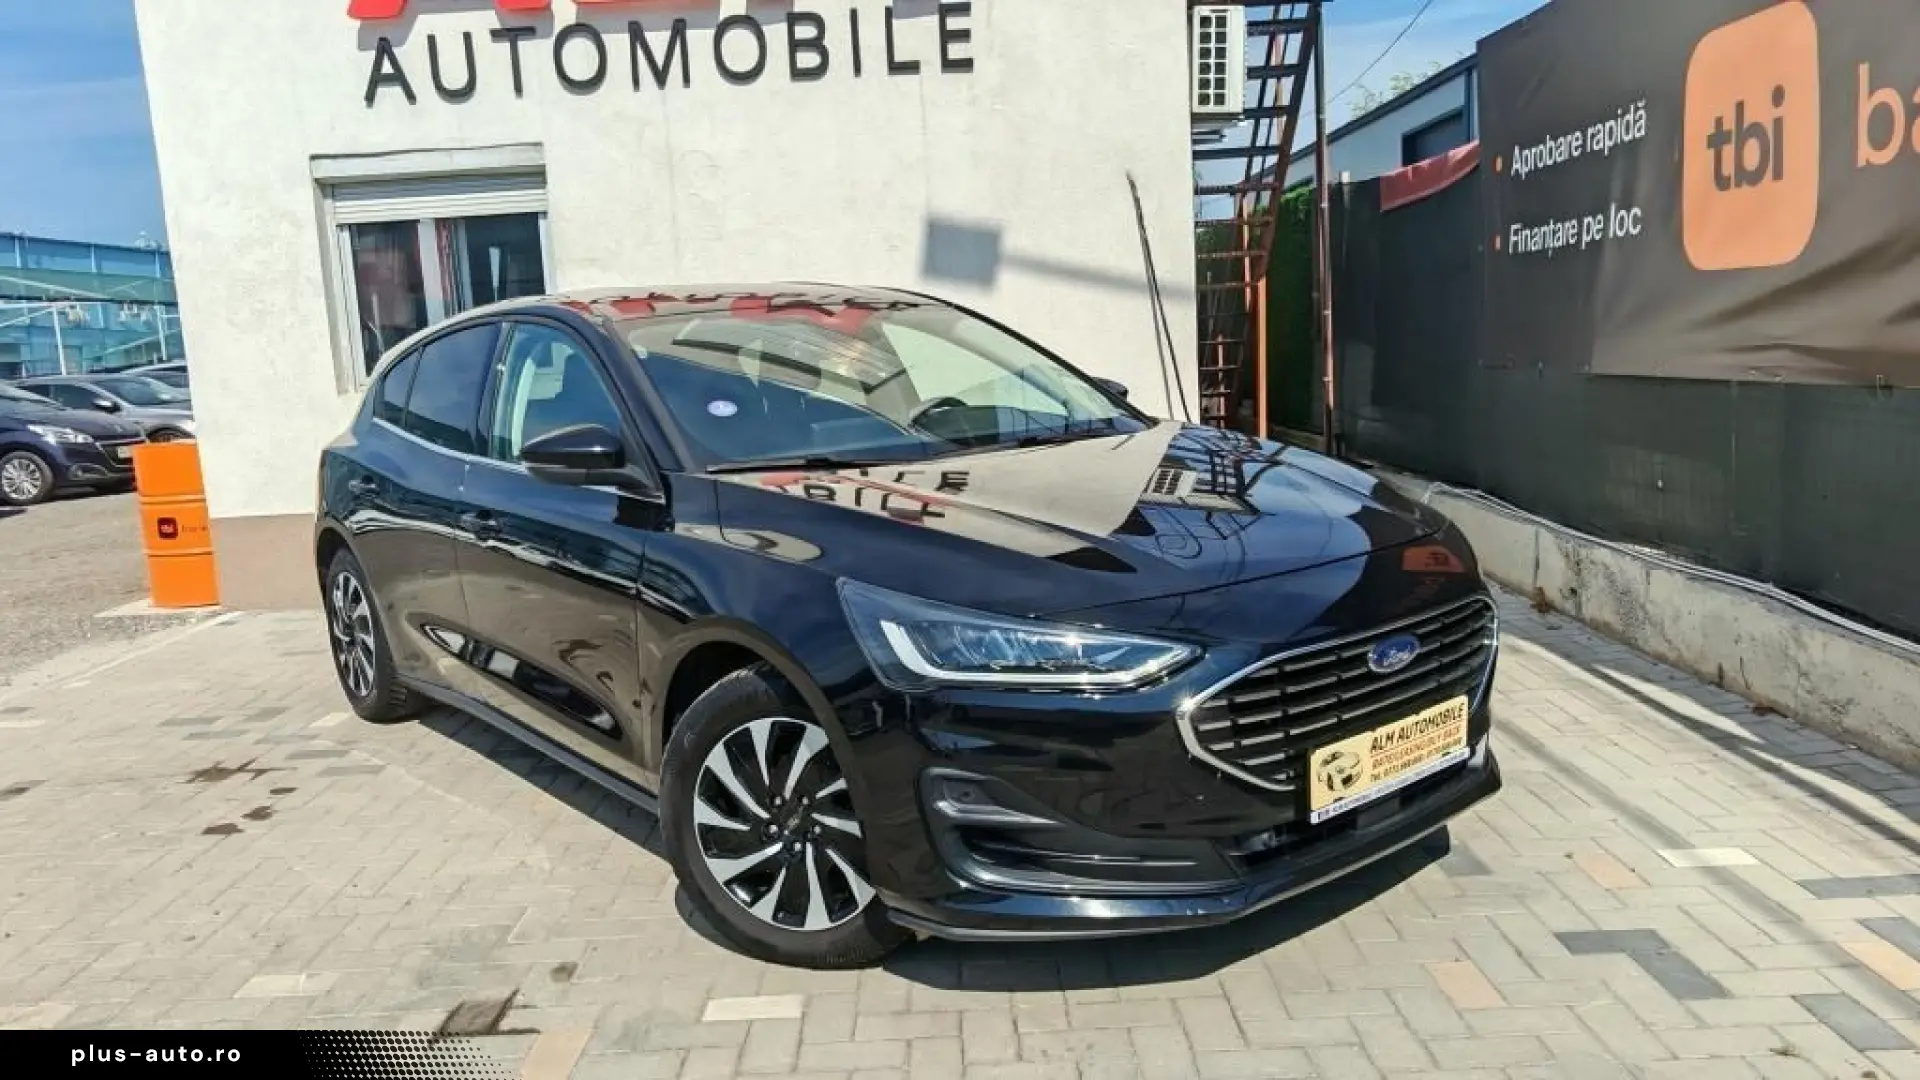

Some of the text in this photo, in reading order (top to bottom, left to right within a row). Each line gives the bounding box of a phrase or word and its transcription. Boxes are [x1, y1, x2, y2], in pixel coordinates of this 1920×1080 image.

[364, 1, 975, 107] AUTOMOBILE
[1511, 99, 1647, 180] Aprobare rapidă
[1706, 84, 1786, 191] tbi
[1856, 62, 1920, 168] b
[1581, 213, 1604, 249] pe
[1608, 202, 1641, 238] loc
[1371, 729, 1396, 754] ALM
[1397, 702, 1465, 742] AUTOMOBILE
